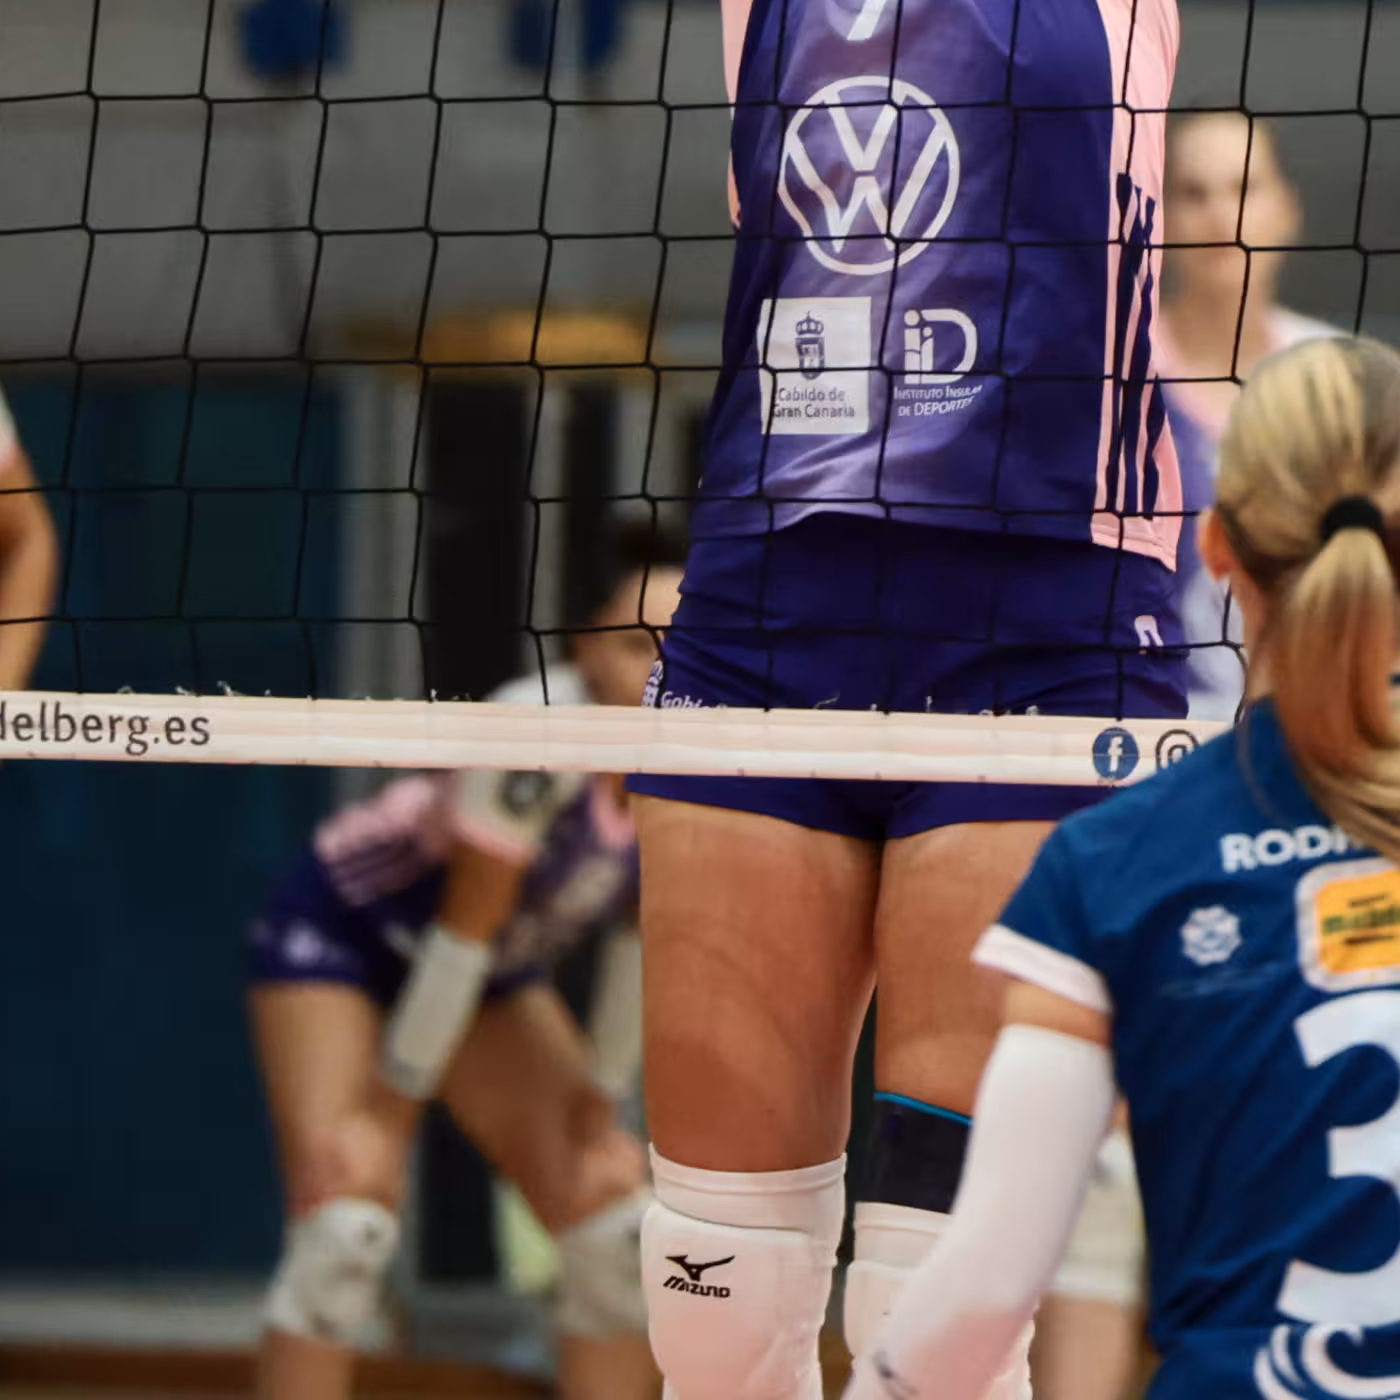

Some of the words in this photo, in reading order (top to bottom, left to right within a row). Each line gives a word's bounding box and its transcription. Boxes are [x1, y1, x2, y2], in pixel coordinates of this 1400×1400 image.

[778, 386, 826, 403] Cabildo
[828, 385, 847, 403] de
[803, 401, 856, 420] Canaria
